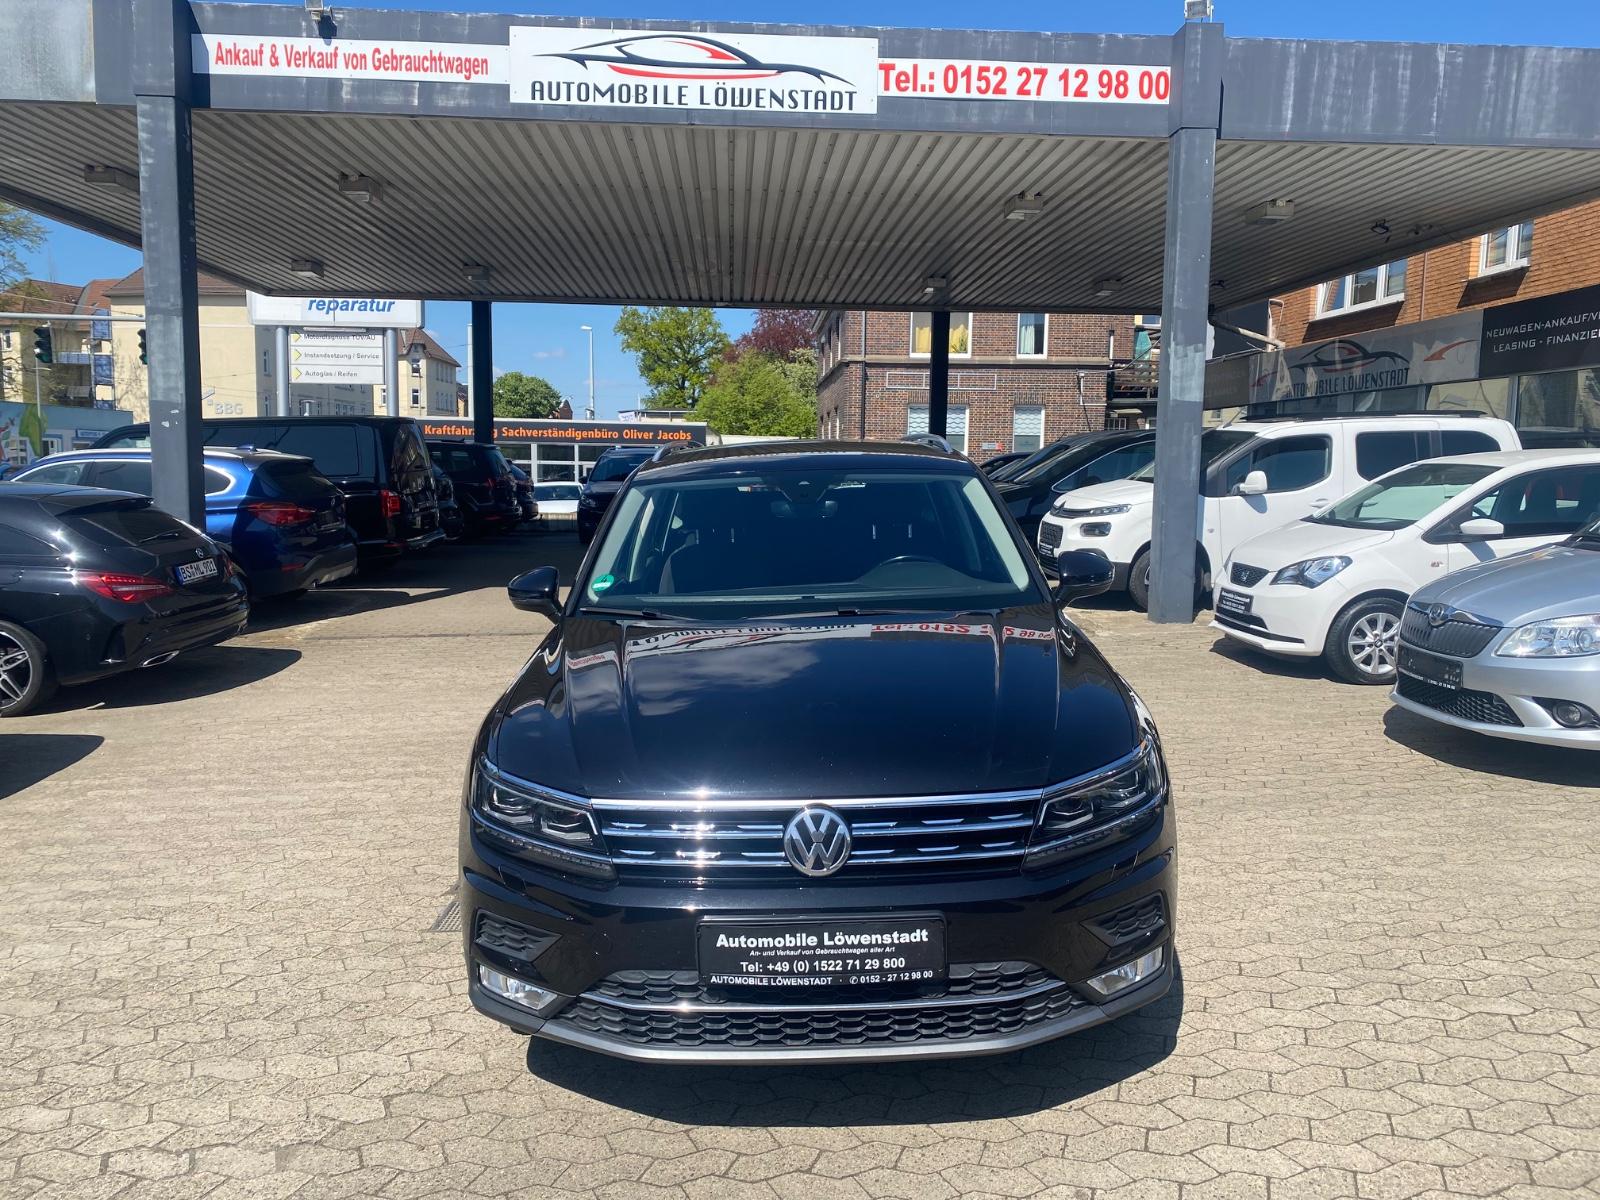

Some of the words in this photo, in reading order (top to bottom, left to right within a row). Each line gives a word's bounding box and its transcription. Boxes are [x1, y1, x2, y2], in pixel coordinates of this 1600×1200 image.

[215, 41, 264, 67] Ankauf
[269, 43, 280, 68] &
[284, 44, 339, 70] Verkauf
[343, 49, 368, 71] von
[371, 46, 489, 81] Gebrauchtwagen
[879, 62, 935, 94] Tel.:
[943, 64, 1007, 96] 0152
[1017, 66, 1048, 97] 27
[1058, 66, 1088, 98] 12
[1098, 67, 1129, 99] 98
[1138, 68, 1170, 101] 00
[530, 80, 688, 106] AUTOMOBILE
[699, 82, 857, 111] LÖWENSTADT
[308, 298, 395, 314] reparatur
[1486, 312, 1600, 338] NEUWAGEN-ANKAUF/V
[1493, 339, 1536, 353] LEASING
[1546, 328, 1600, 345] FINANZIE
[304, 352, 351, 360] Instandsetzung
[1343, 367, 1410, 391] LÖWENSTADT
[502, 426, 618, 441] Sachverständigenbüro
[623, 429, 653, 440] Oliver
[657, 429, 692, 440] Jacobs
[716, 932, 818, 948] Automobile
[823, 929, 929, 946] Löwenstadt
[815, 947, 869, 955] Gebrauchtwagen
[740, 961, 763, 972] Tel:
[766, 961, 789, 972] +49
[793, 960, 810, 973] (0)
[813, 959, 843, 971] 1522
[846, 959, 860, 970] 71
[866, 958, 879, 970] 29
[883, 957, 905, 969] 800
[710, 975, 768, 985] AUTOMOBILE
[770, 975, 832, 986] LÖWENSTADT
[860, 974, 880, 984] 0152
[887, 973, 897, 982] 27
[900, 972, 910, 981] 12
[911, 971, 921, 980] 98
[922, 970, 933, 979] 00
